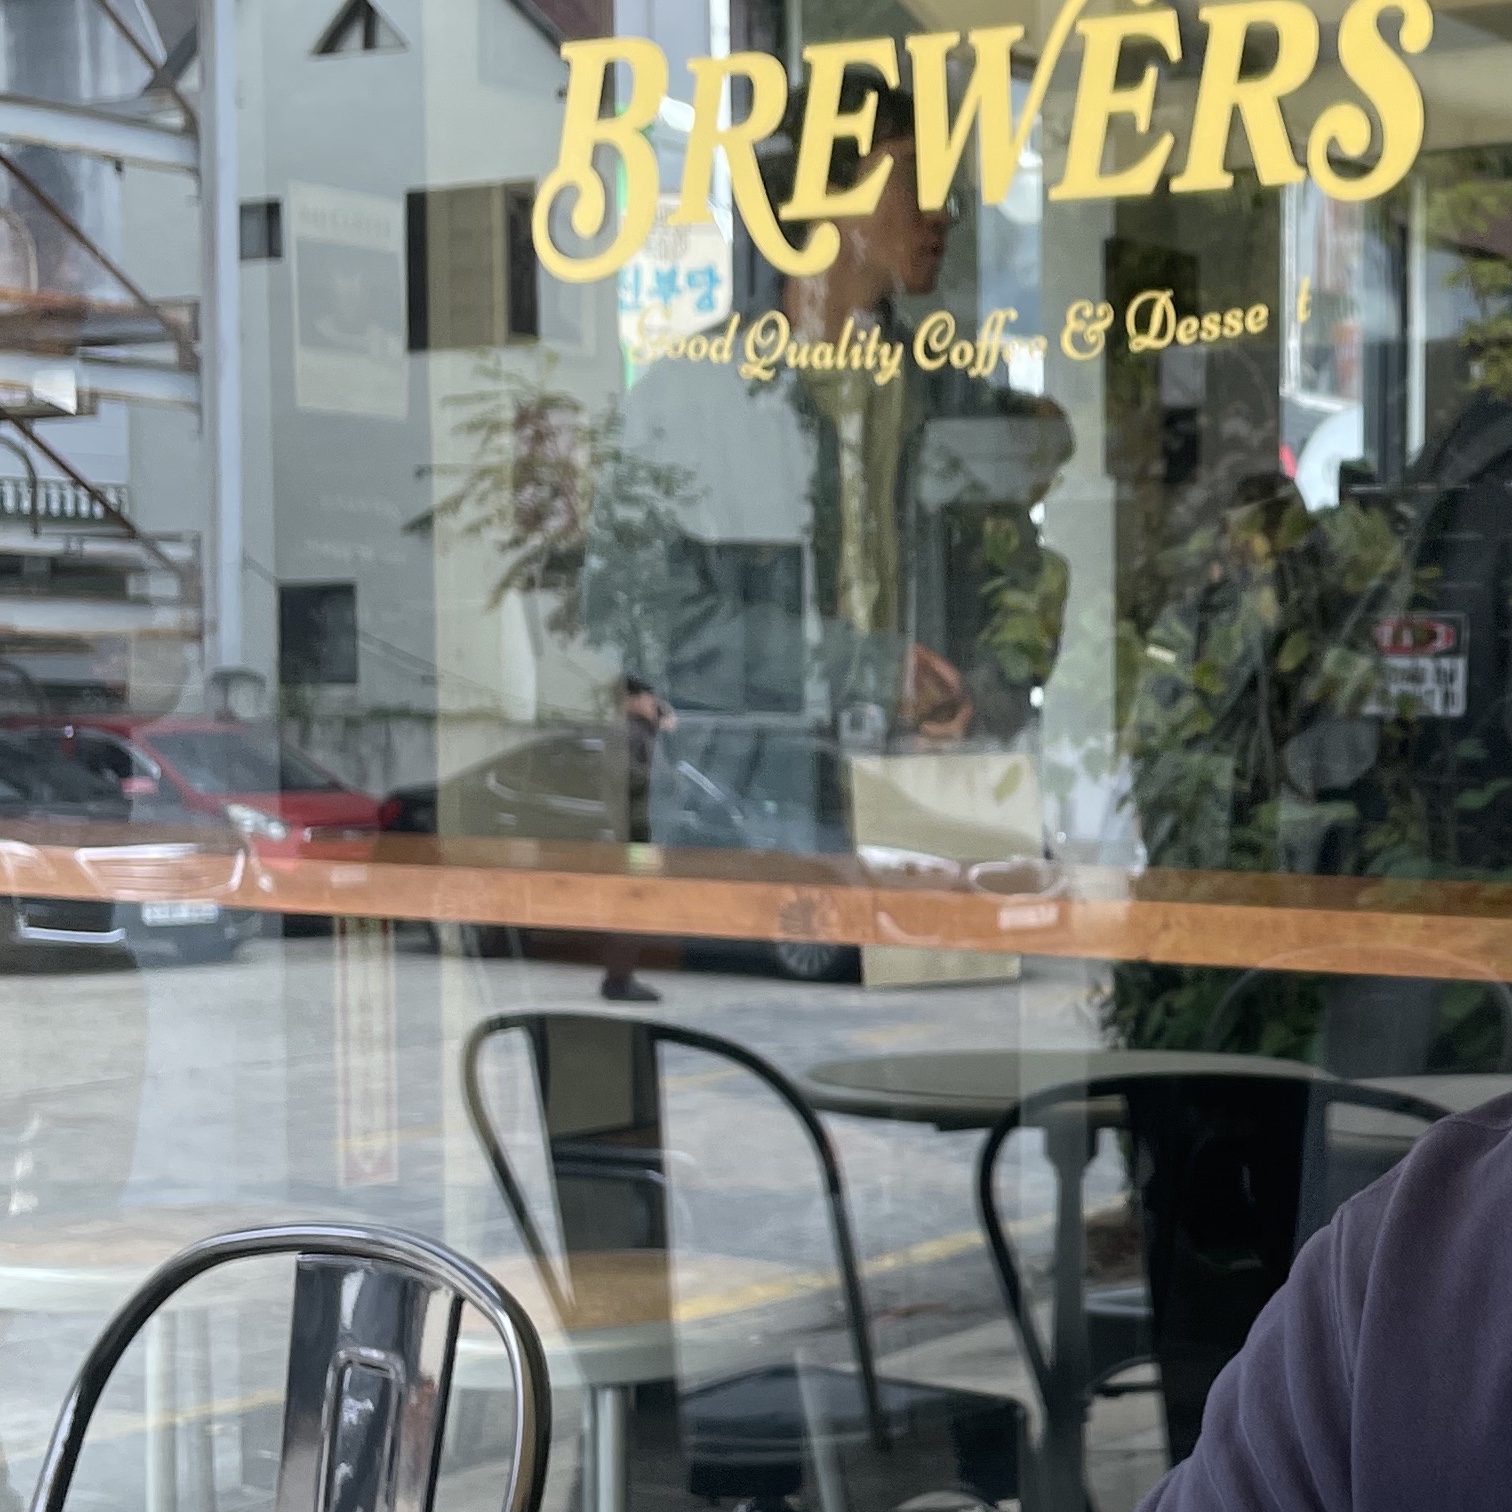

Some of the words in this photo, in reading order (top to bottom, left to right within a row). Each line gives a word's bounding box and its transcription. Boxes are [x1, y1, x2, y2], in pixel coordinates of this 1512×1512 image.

[532, 0, 1433, 282] BREWERS
[739, 310, 903, 385] Quality
[1061, 300, 1114, 361] &
[1126, 276, 1311, 353] Desset
